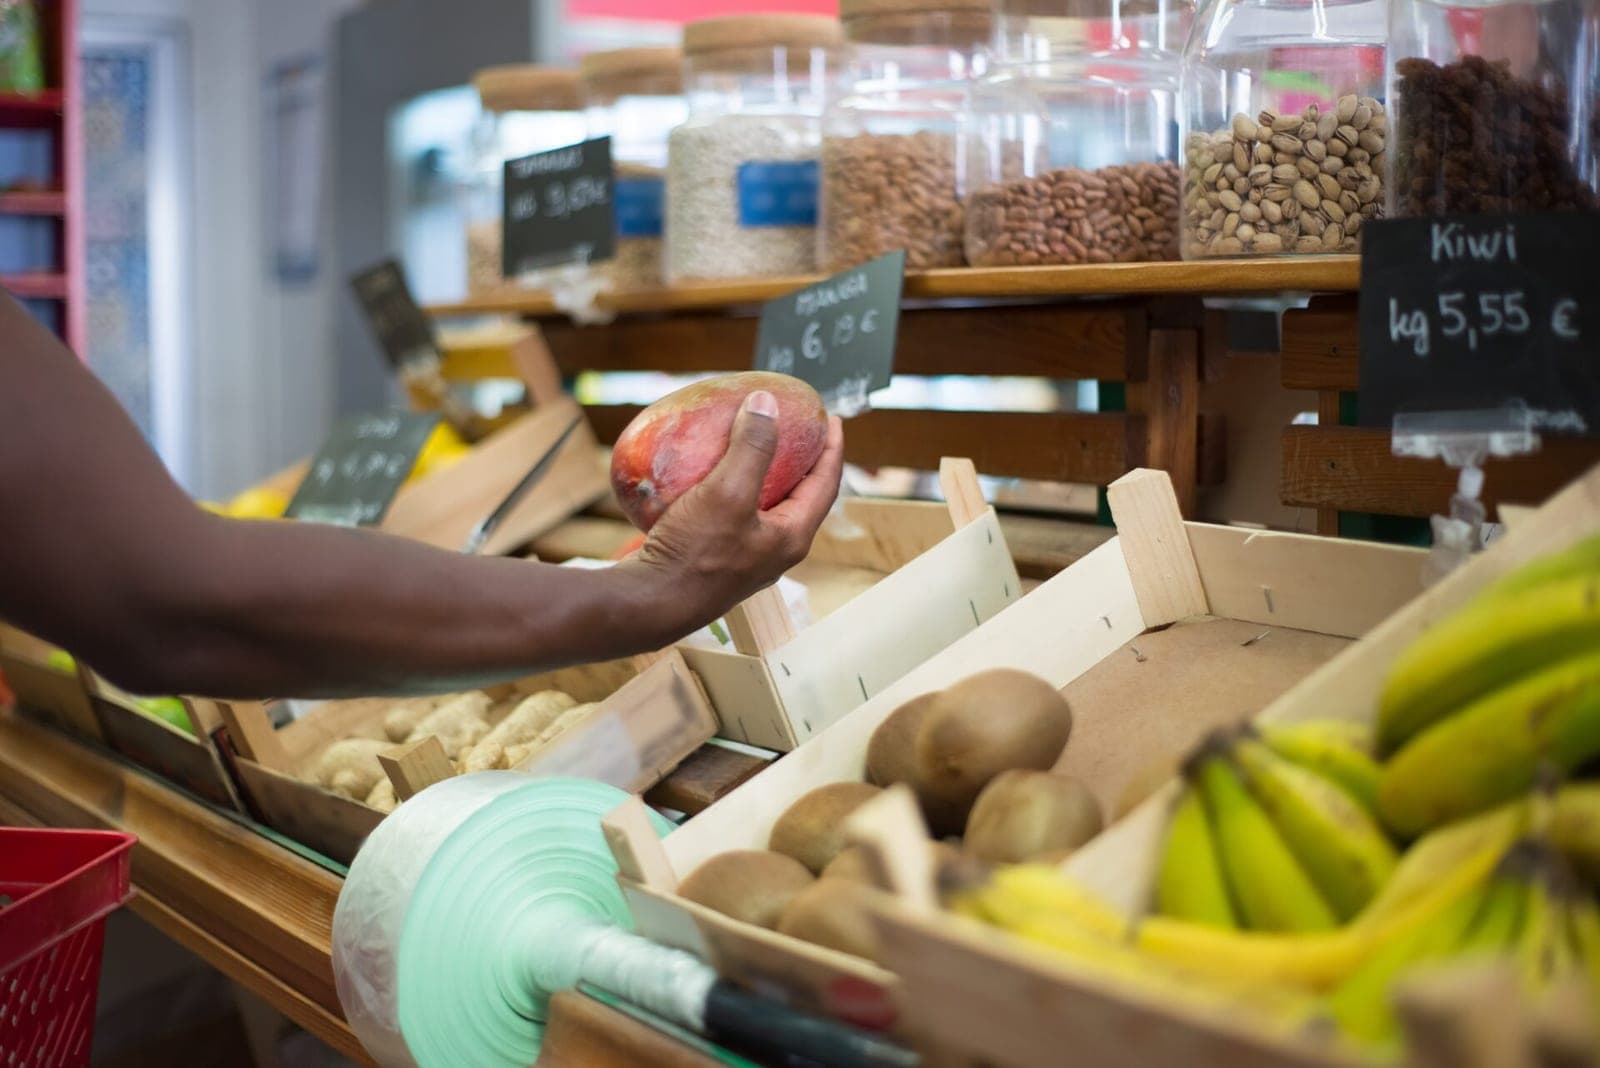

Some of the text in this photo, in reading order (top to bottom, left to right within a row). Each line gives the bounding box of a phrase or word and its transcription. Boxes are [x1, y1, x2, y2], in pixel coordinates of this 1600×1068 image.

[1431, 223, 1517, 262] Kiwi
[1389, 292, 1580, 356] kg 5,55 €
